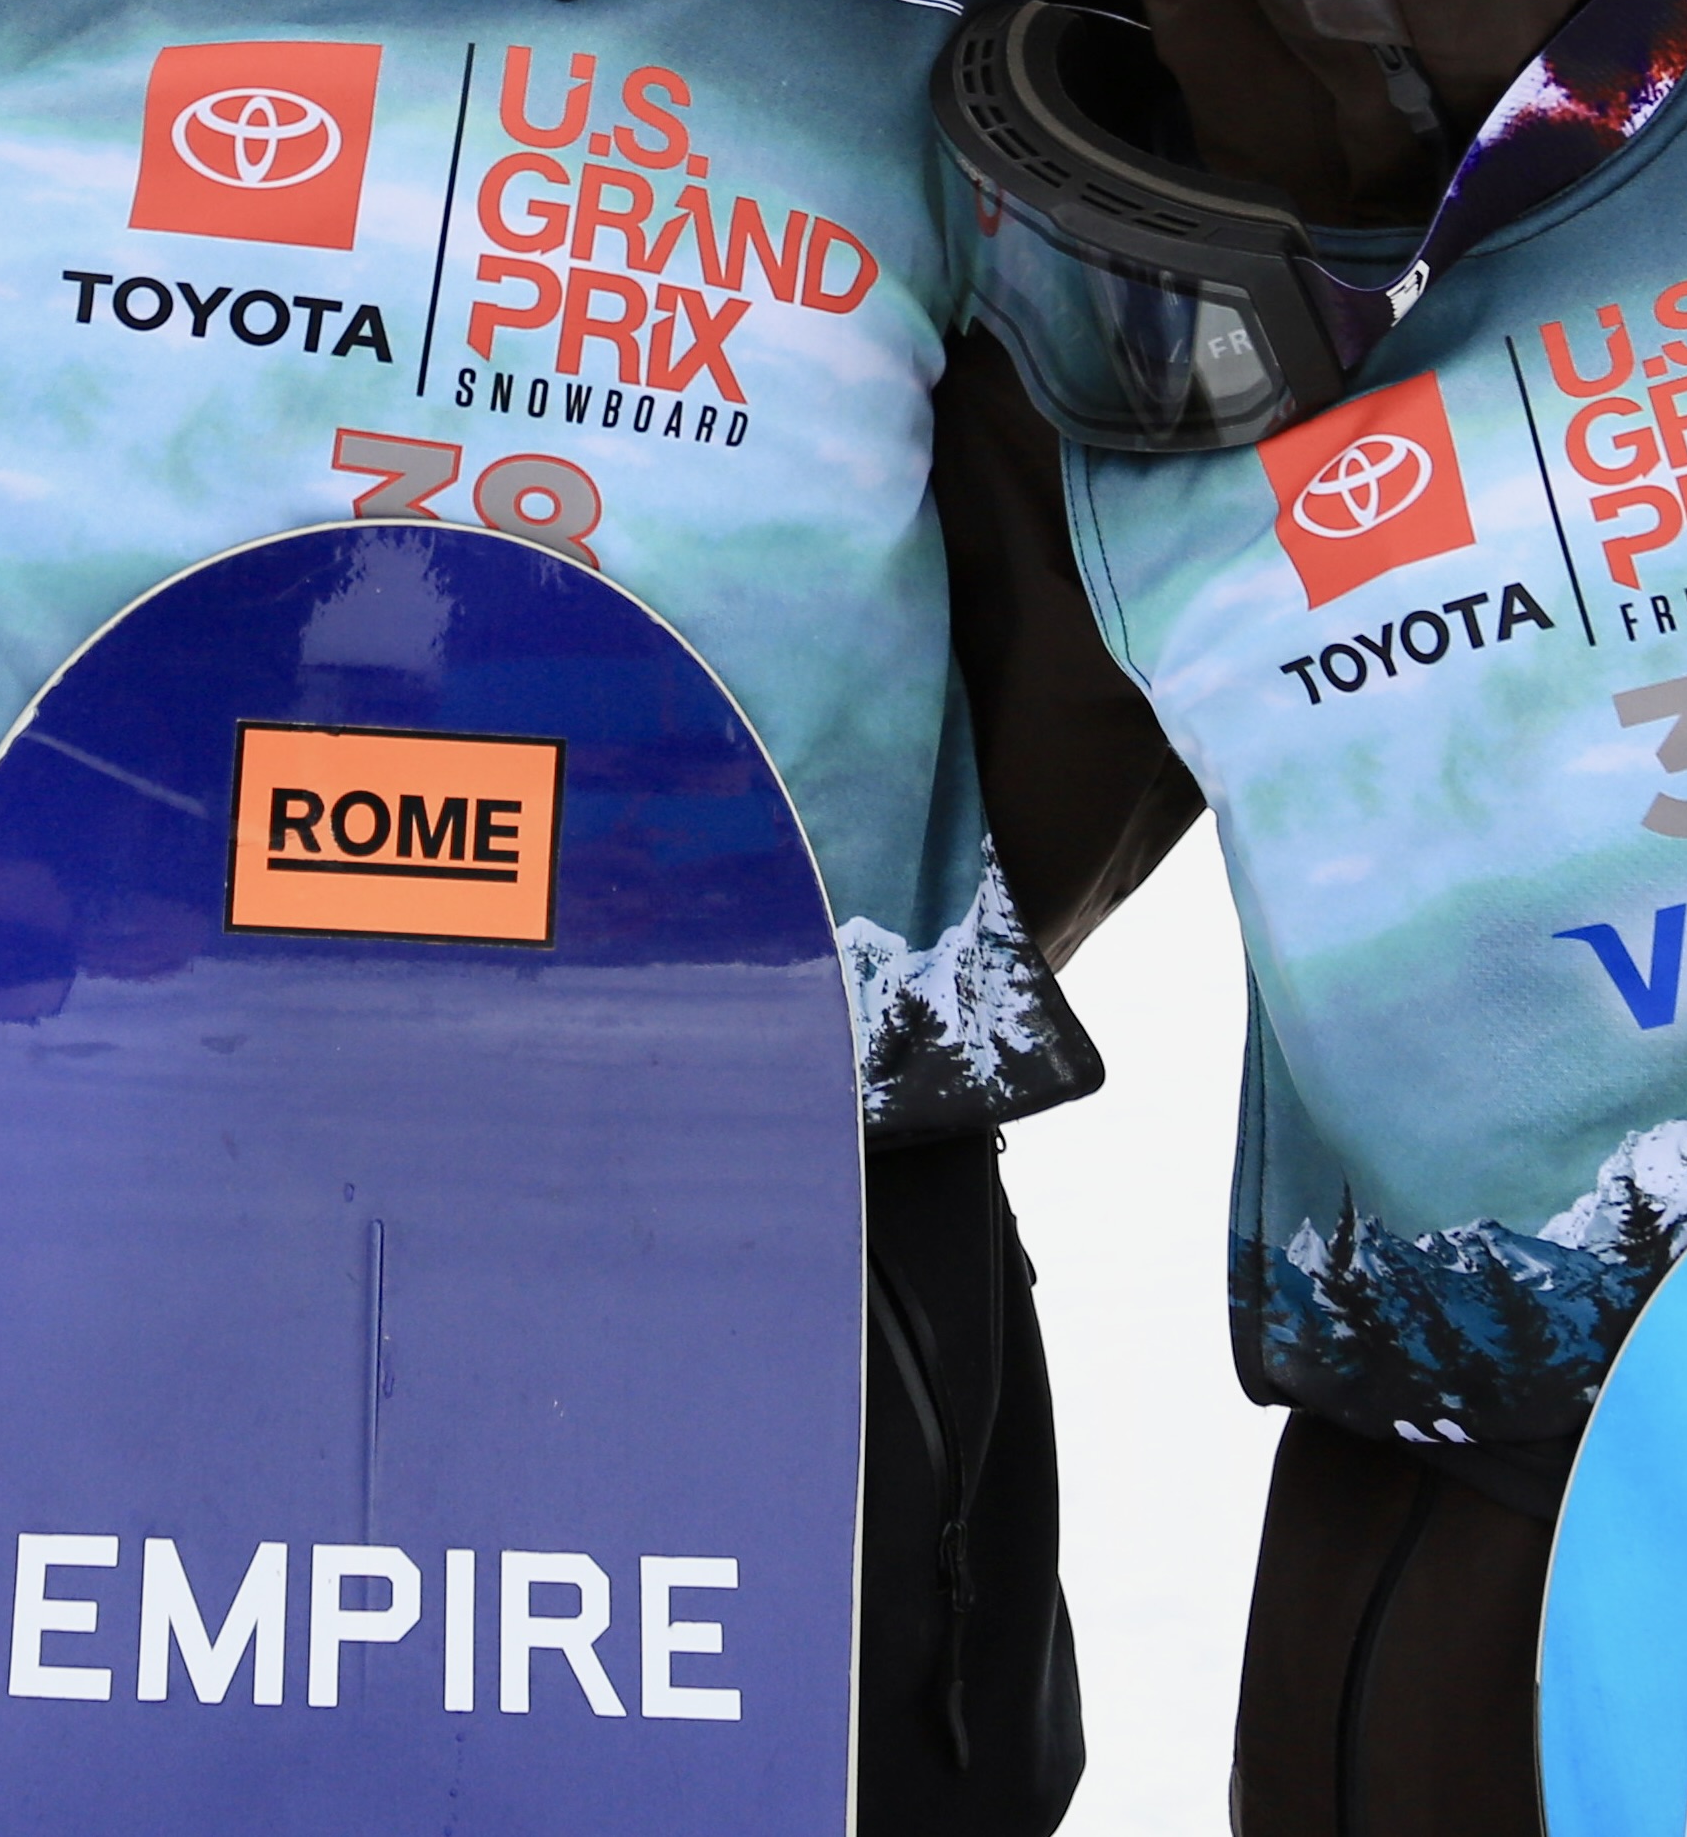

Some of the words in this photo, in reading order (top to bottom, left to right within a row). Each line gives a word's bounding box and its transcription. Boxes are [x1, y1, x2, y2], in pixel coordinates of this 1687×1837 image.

[498, 45, 708, 176] U.S.
[477, 151, 878, 314] GRAND
[61, 269, 392, 363] TOYOTA
[454, 367, 750, 448] SNOWBOARD
[1279, 582, 1556, 706] TOYOTA
[269, 787, 524, 863] ROME
[8, 1533, 742, 1721] EMPIRE
